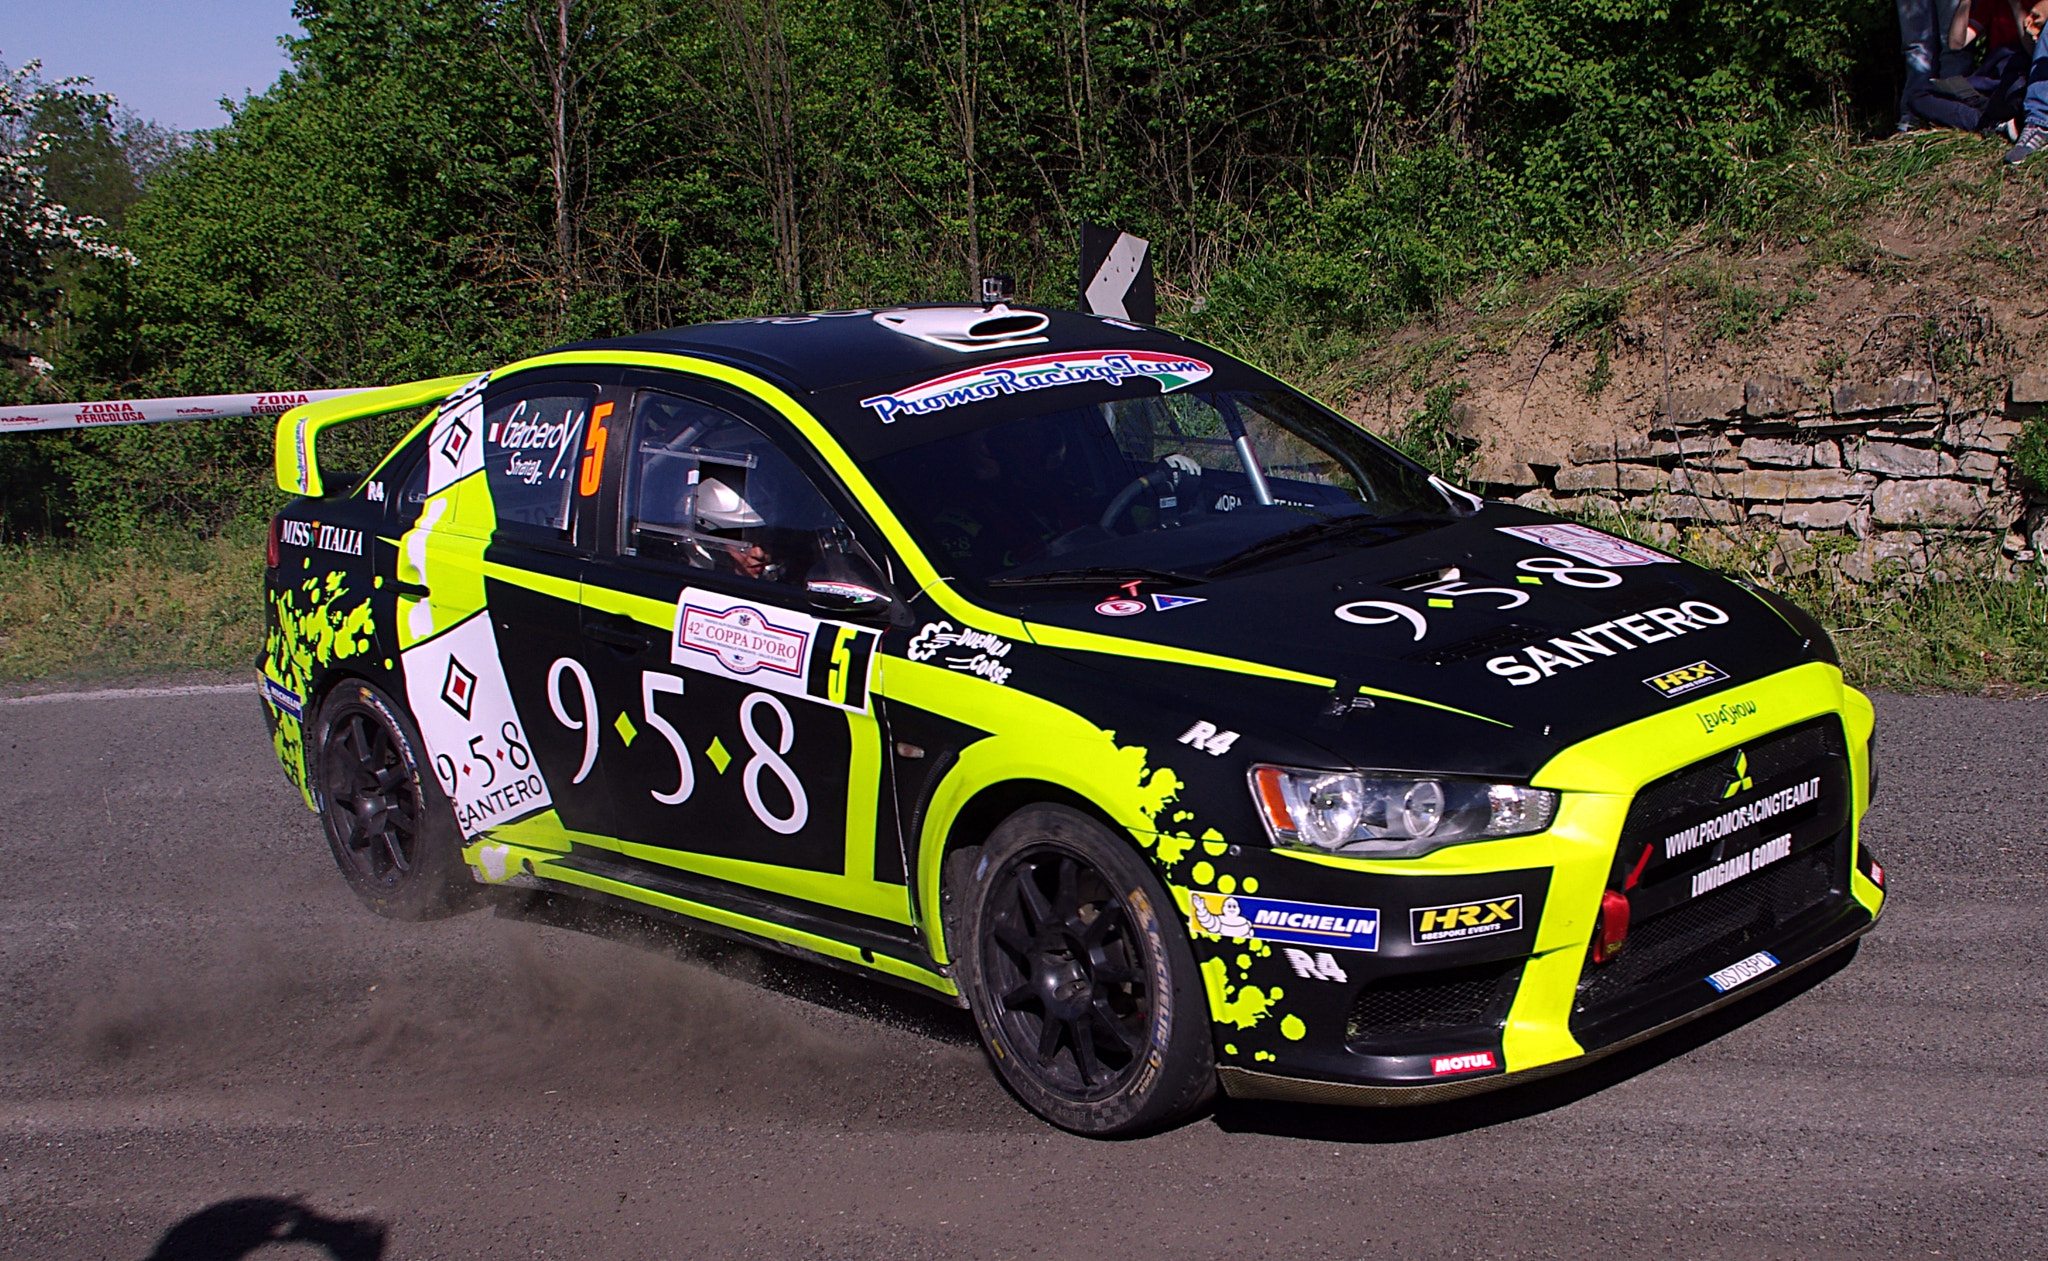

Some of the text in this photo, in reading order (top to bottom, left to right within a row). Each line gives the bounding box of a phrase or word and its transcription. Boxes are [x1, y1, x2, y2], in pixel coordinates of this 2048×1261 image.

[255, 394, 310, 406] ZONA
[860, 354, 1209, 423] PromoRacingTeam
[75, 411, 147, 425] PERICOLOSA
[80, 403, 134, 414] ZONA
[579, 401, 615, 497] 5
[367, 480, 385, 502] R4
[280, 519, 363, 556] MISS ITALIA
[705, 625, 749, 648] COPPA
[752, 636, 797, 660] D'ORO
[955, 627, 1013, 658] DUEMILA
[1486, 600, 1730, 687] SANTERO
[827, 626, 860, 704] 5
[968, 653, 1013, 685] CORSE
[1653, 663, 1717, 691] HRX
[1176, 720, 1241, 756] R4
[458, 774, 543, 830] SANTERO
[1664, 776, 1821, 860] WWW.PROMORACINGTEAM.IT
[1254, 909, 1376, 935] MICHELIN
[1418, 898, 1517, 932] HRX
[1467, 922, 1501, 937] EVENTS
[1283, 948, 1348, 983] R4
[1713, 953, 1773, 989] DS703PC
[1435, 1054, 1492, 1072] MOTUL
